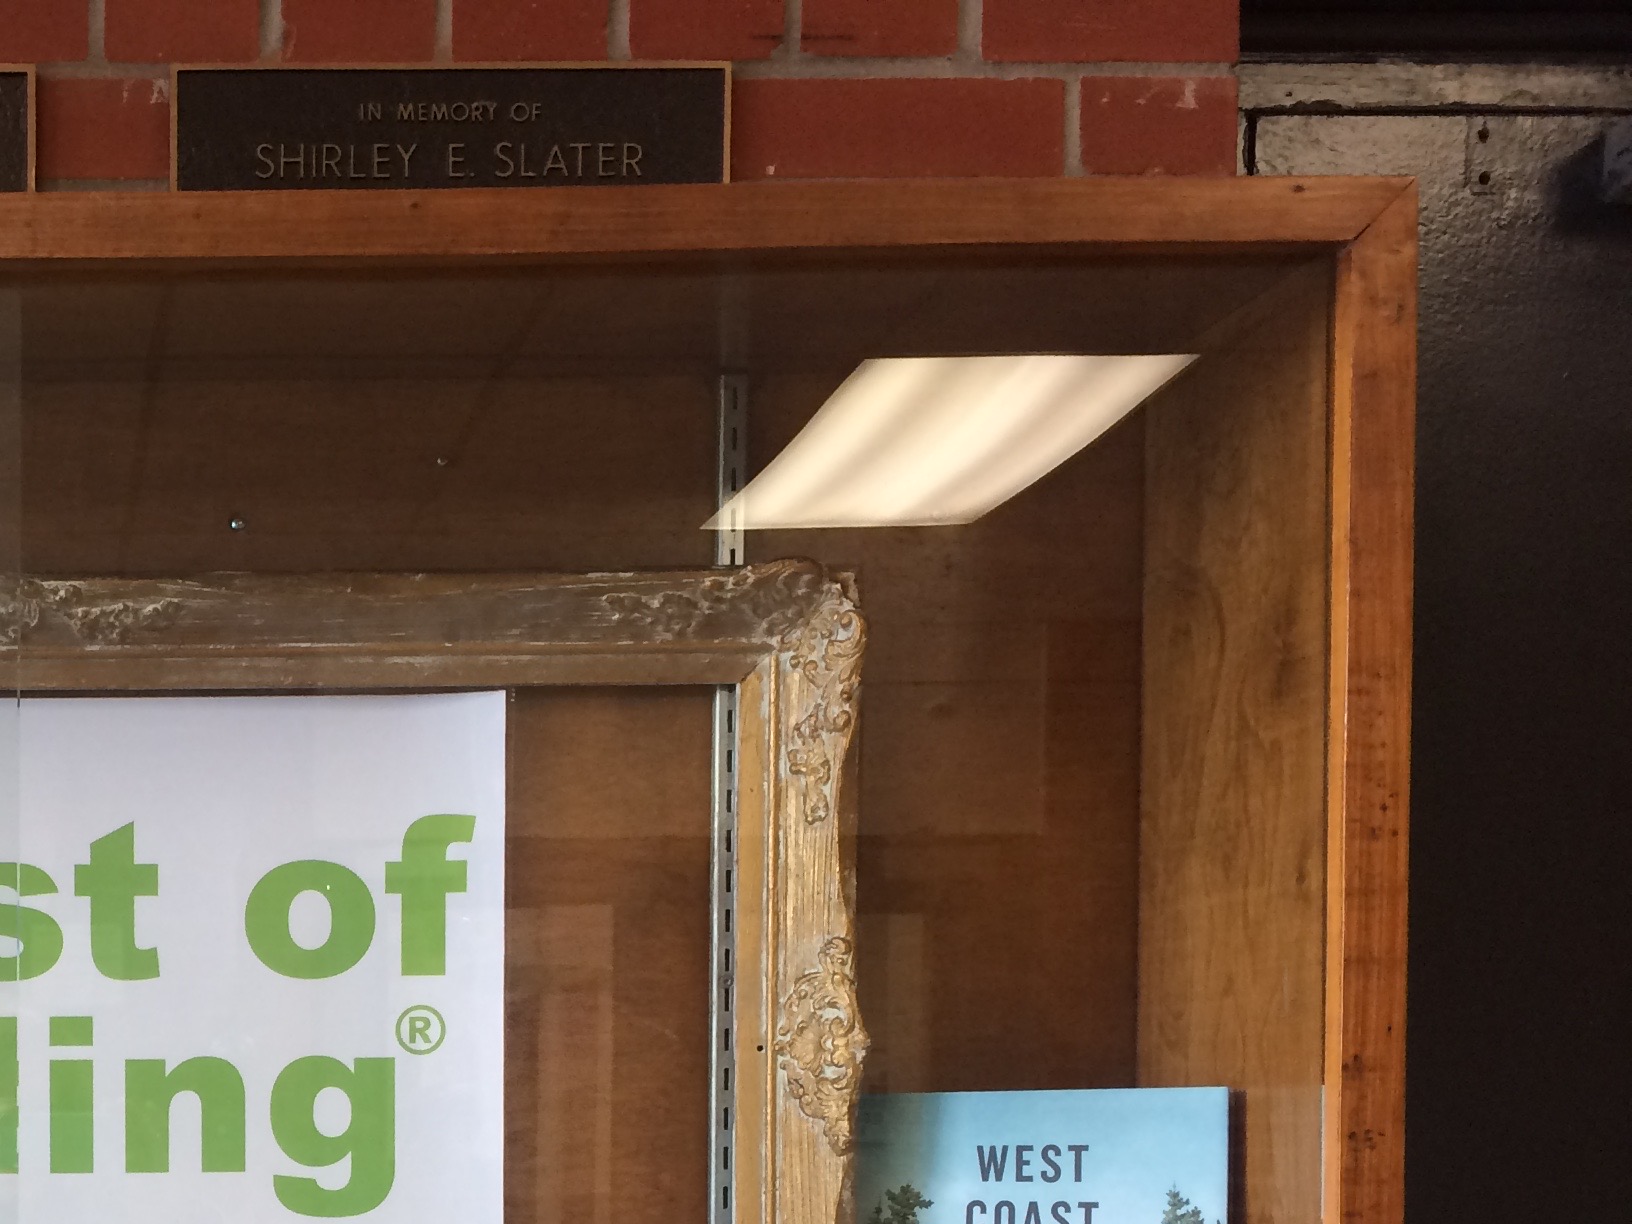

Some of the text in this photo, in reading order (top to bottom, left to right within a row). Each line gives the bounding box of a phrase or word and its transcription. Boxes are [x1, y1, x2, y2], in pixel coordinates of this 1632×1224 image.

[359, 102, 542, 122] IN MEMORY OF
[254, 141, 644, 180] SHIRLEY E. SLATER
[244, 813, 477, 981] of
[976, 1143, 1091, 1184] WEST
